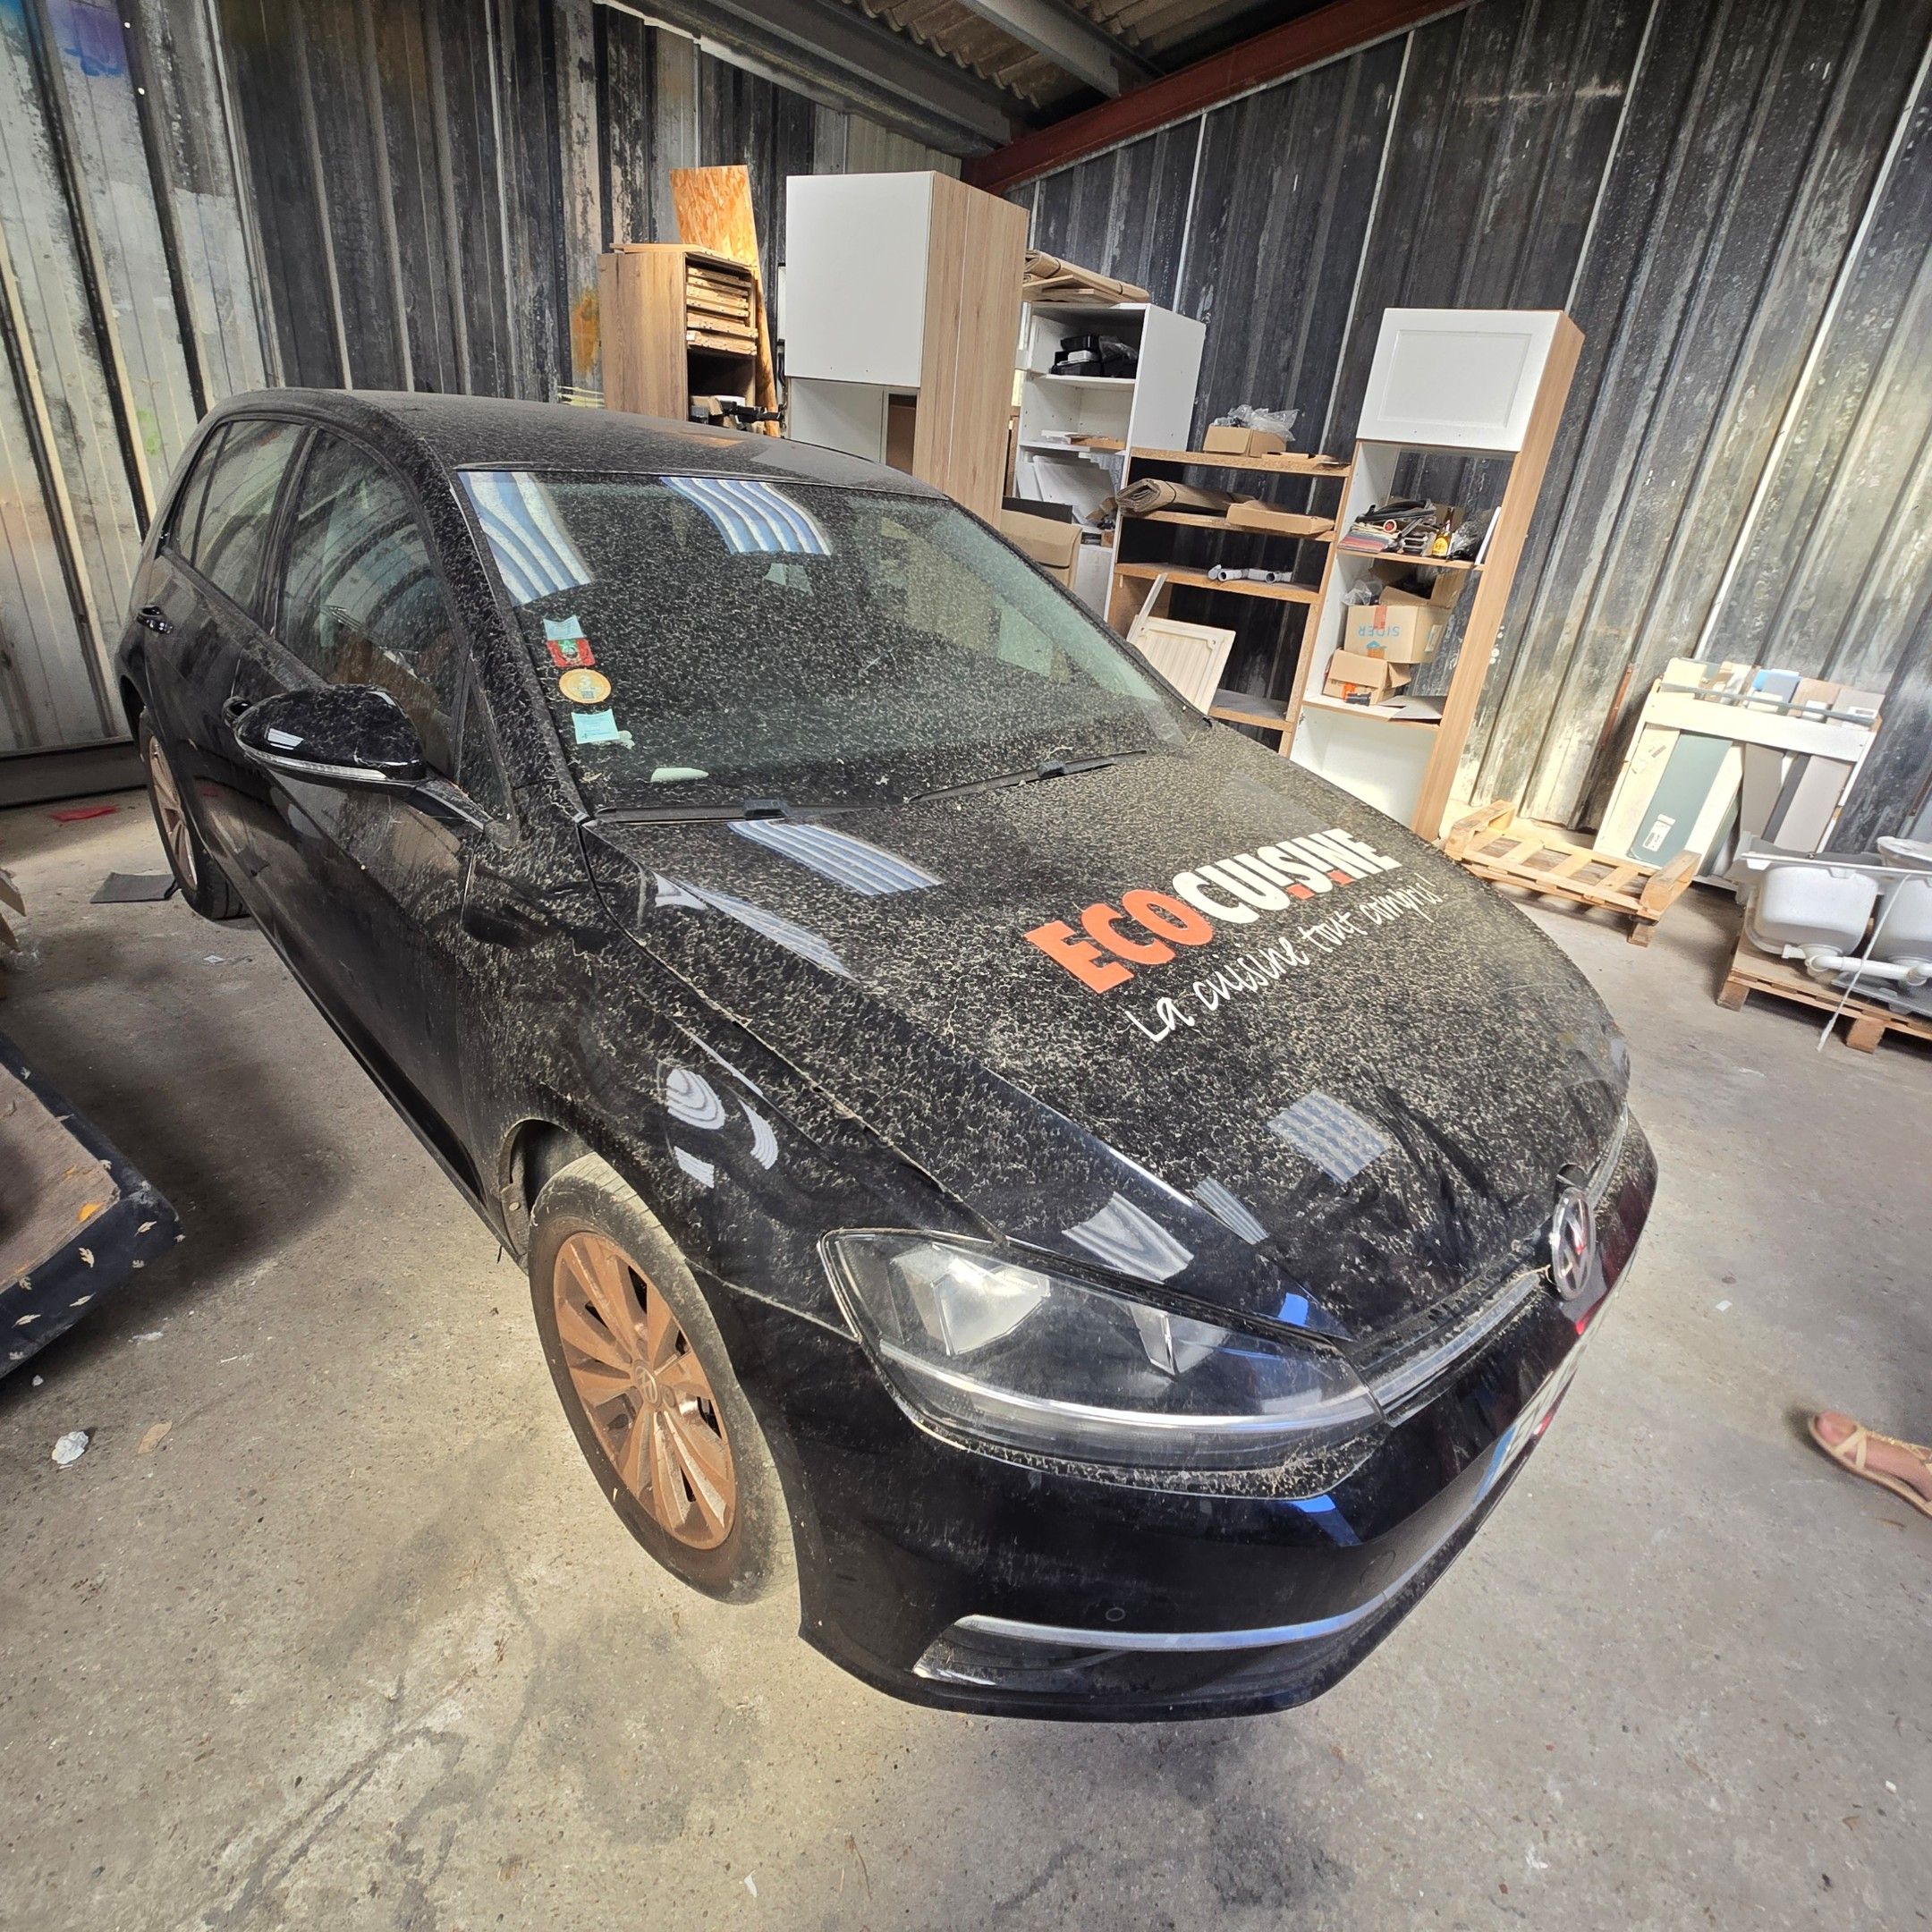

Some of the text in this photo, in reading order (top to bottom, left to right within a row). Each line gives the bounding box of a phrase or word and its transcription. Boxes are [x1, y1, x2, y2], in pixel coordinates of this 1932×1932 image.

[1124, 996, 1195, 1042] La
[1192, 936, 1311, 1012] cuisine
[1298, 911, 1368, 953] tout
